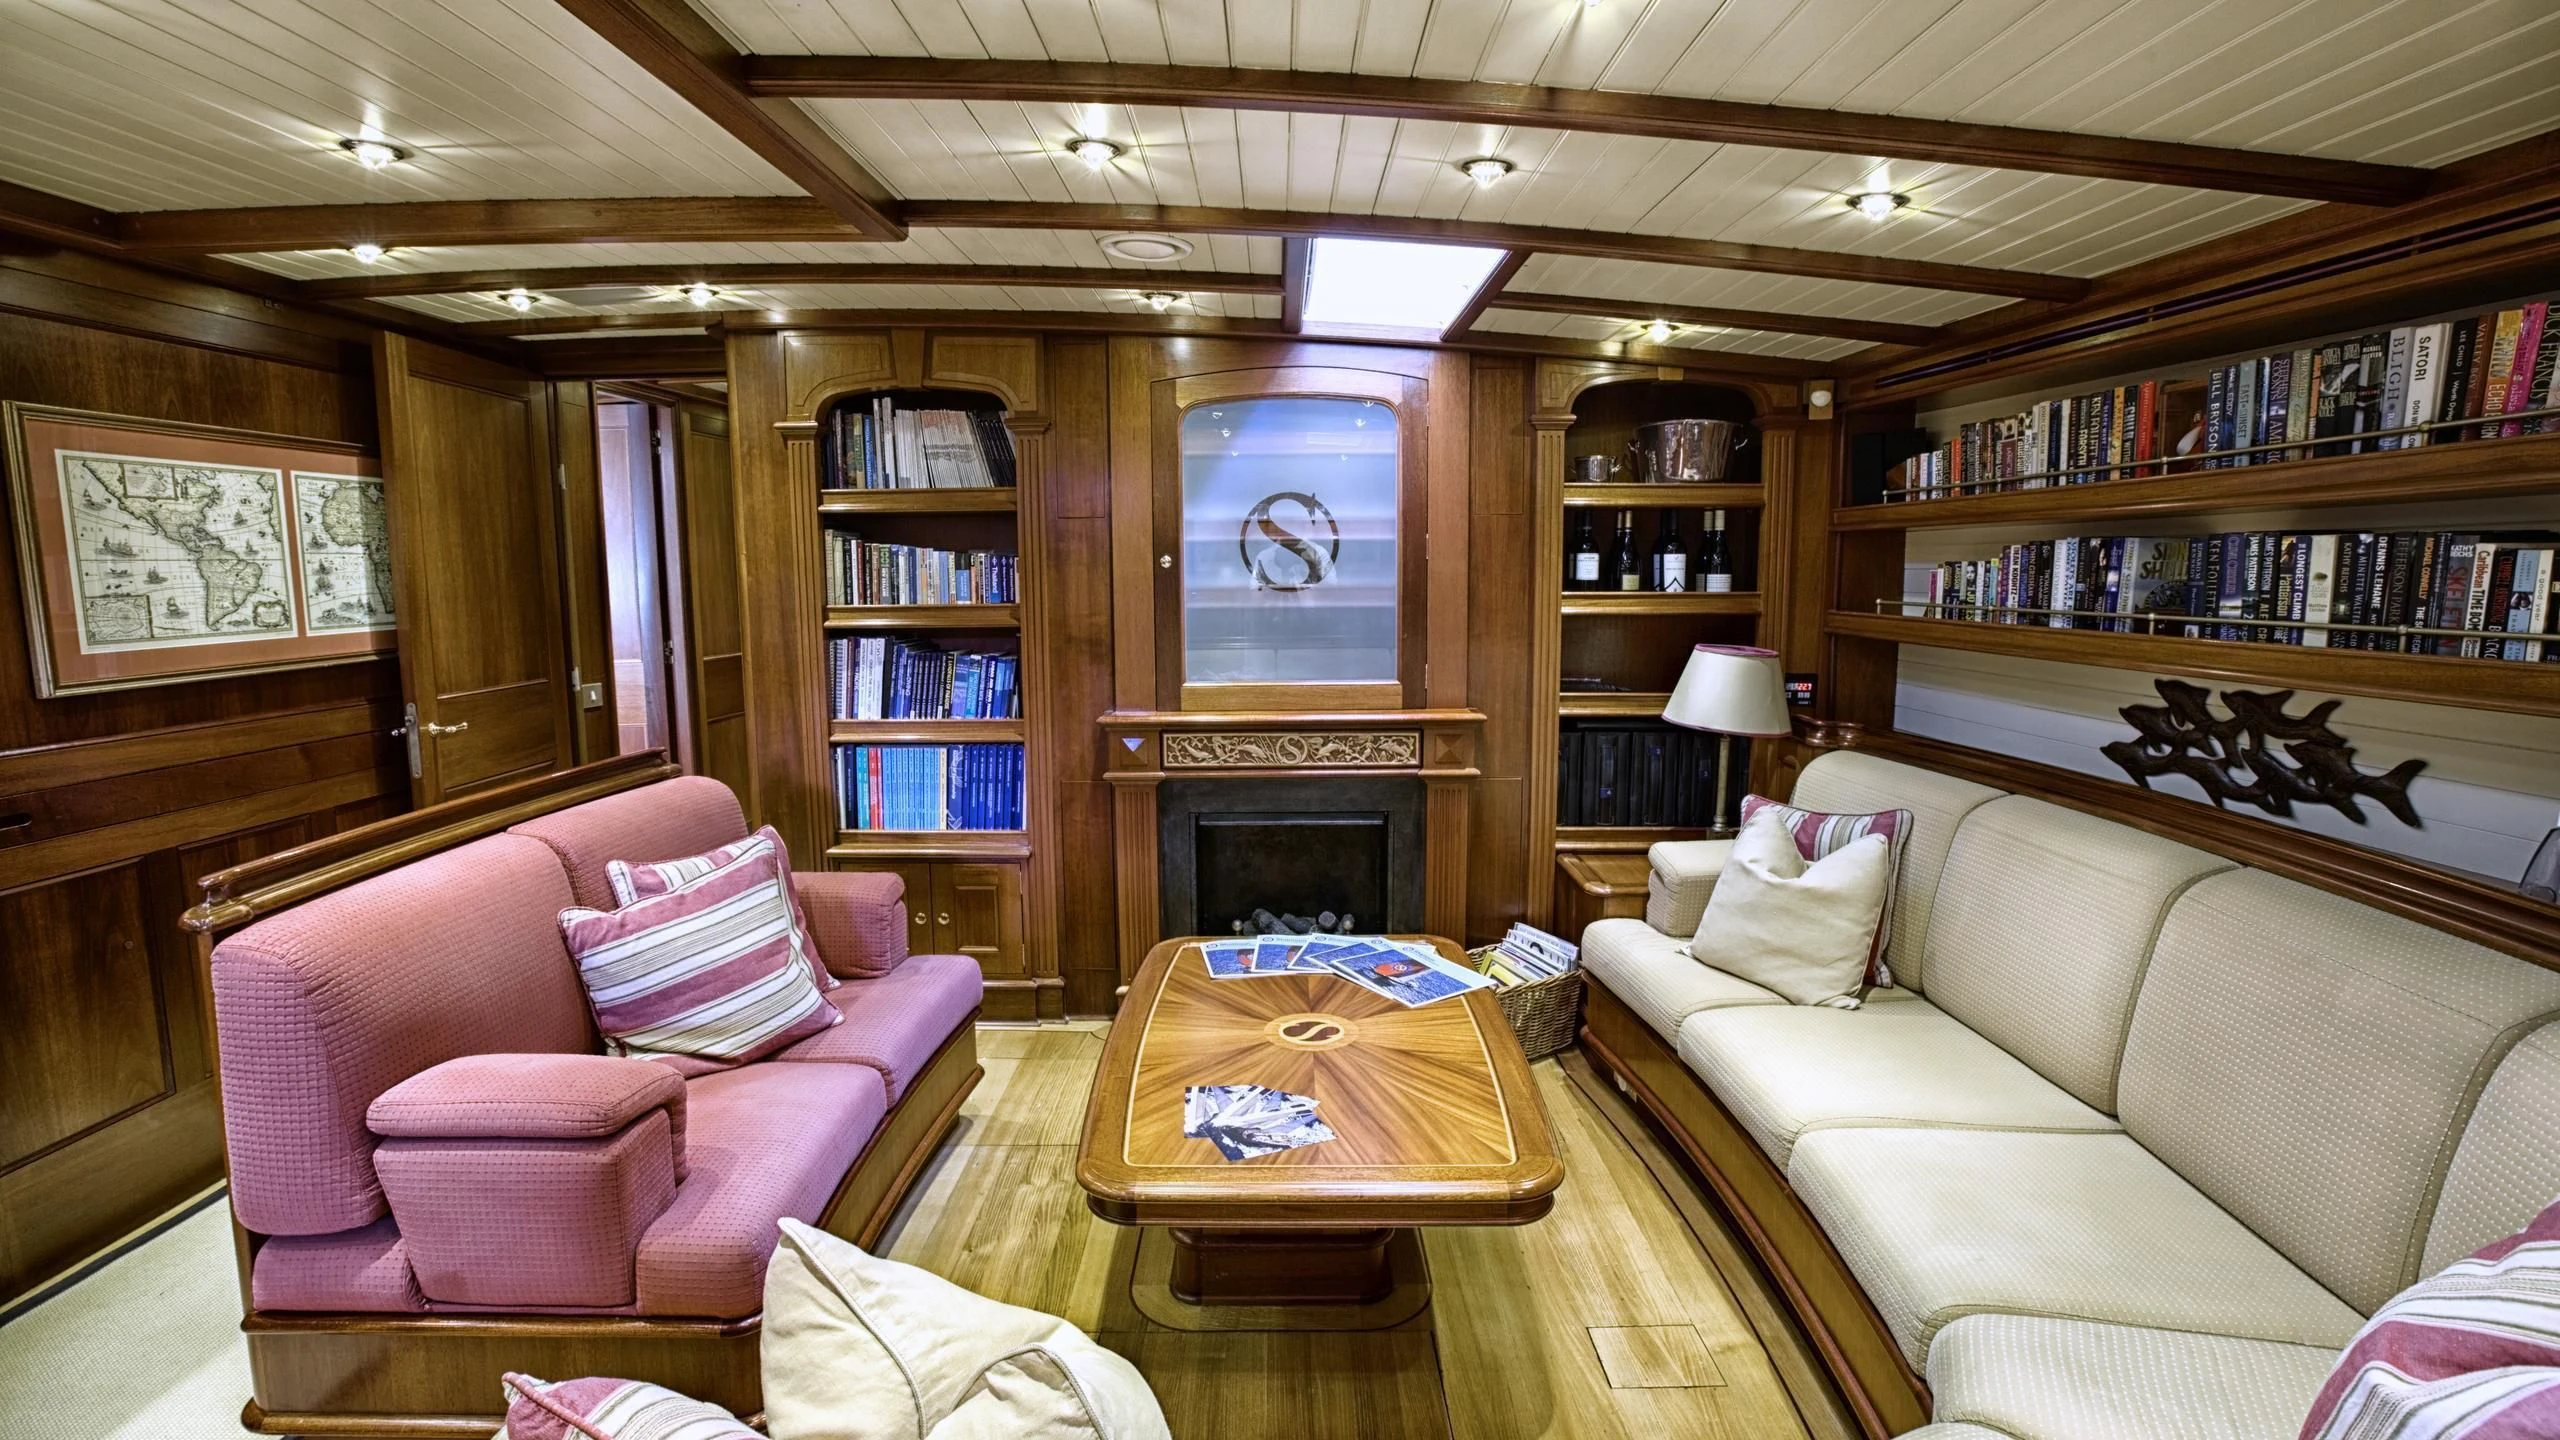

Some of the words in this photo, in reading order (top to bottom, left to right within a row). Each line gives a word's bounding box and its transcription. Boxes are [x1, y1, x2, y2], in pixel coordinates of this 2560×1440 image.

[2459, 331, 2467, 342] LEE
[2546, 305, 2560, 339] DICK
[2415, 336, 2431, 381] SATORI
[2456, 345, 2465, 367] CHILD
[2472, 324, 2487, 364] VALLEY
[2270, 360, 2282, 400] COONTS
[2278, 359, 2290, 398] STEPHEN
[2388, 336, 2405, 401] BLIGH
[2468, 368, 2479, 390] BOY
[2530, 344, 2560, 399] FRANCIS
[2211, 372, 2222, 398] BILL
[2450, 381, 2460, 401] Worth
[2485, 384, 2506, 410] ECHO
[2507, 385, 2522, 411] olivia
[2091, 397, 2101, 415] KEN
[2225, 392, 2234, 416] EDDY
[2412, 400, 2420, 416] DON
[2445, 403, 2456, 421] Dying
[2089, 418, 2100, 457] FOLLETT
[2208, 403, 2220, 453] BRYSON
[2077, 428, 2088, 466] FORSYTH
[2069, 542, 2077, 580] VIOLETS
[2209, 540, 2221, 561] KEN
[2249, 537, 2259, 556] JAMES
[2263, 537, 2275, 556] JAMES
[2343, 542, 2352, 565] KATHY
[2375, 536, 2387, 571] DENNIS
[2423, 537, 2434, 566] MICHAEL
[2247, 557, 2257, 591] PATTERSON
[2261, 557, 2273, 591] PATTERSON
[2294, 549, 2306, 590] LONGEST
[2339, 567, 2349, 593] REICHS
[2355, 555, 2368, 591] MINETTE
[2391, 537, 2409, 593] JEFFERSON
[2474, 551, 2490, 588] Caribbean
[2495, 556, 2513, 585] CAMPBELL
[2011, 568, 2019, 595] KOONTZ
[2028, 565, 2036, 596] GRISHAM
[2206, 565, 2219, 608] FOLLETT
[2276, 574, 2292, 616] Patterson
[2371, 573, 2383, 609] LEHANE
[2419, 567, 2430, 599] CONNELLY
[2537, 578, 2545, 600] good
[2258, 603, 2269, 620] ALE
[2292, 592, 2303, 620] CLIMB
[2352, 594, 2363, 625] WALTER
[2416, 606, 2425, 620] THE
[2471, 590, 2485, 610] TIME
[2490, 587, 2507, 623] ARMSTRONG
[2467, 612, 2481, 631] BOM
